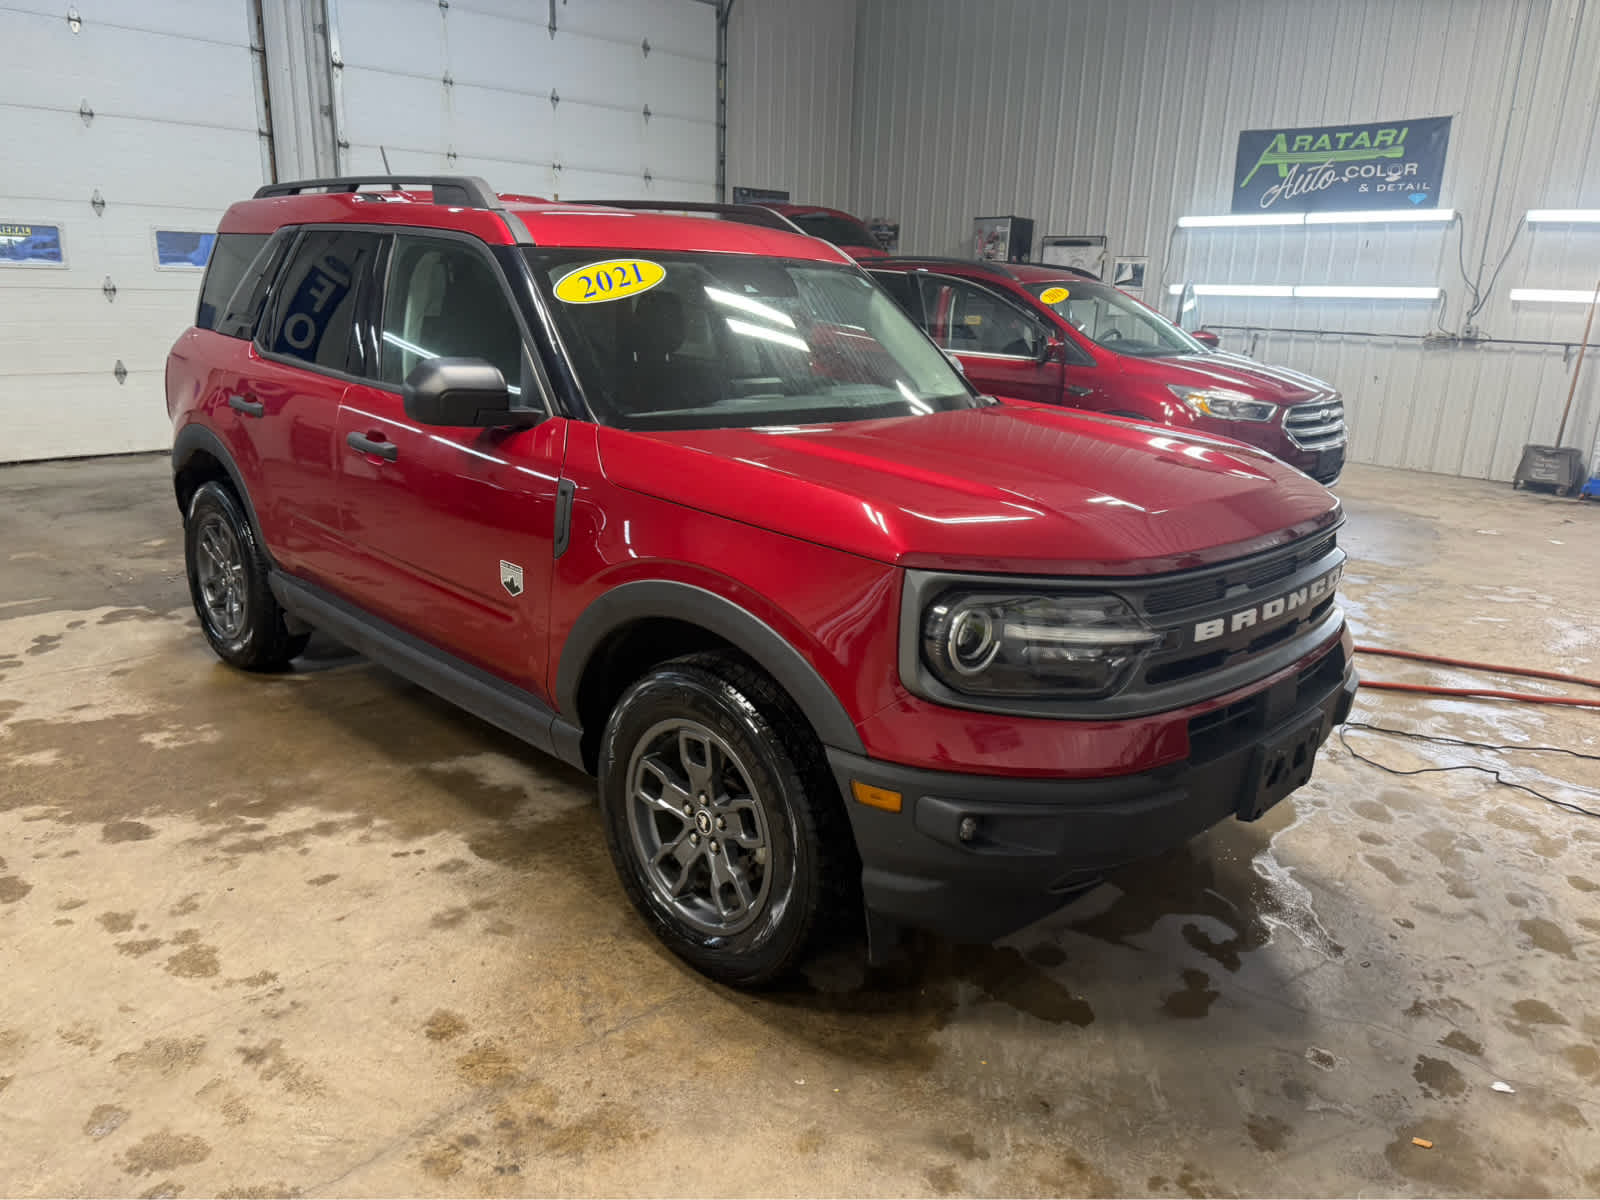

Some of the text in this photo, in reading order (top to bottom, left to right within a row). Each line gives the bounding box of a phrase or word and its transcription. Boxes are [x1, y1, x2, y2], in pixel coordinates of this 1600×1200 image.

[1240, 127, 1409, 188] ARATARI
[1260, 158, 1418, 209] Auto COLOR
[1358, 182, 1431, 192] & DETAIL
[577, 263, 645, 299] 2021
[1193, 566, 1341, 643] BRONCO
